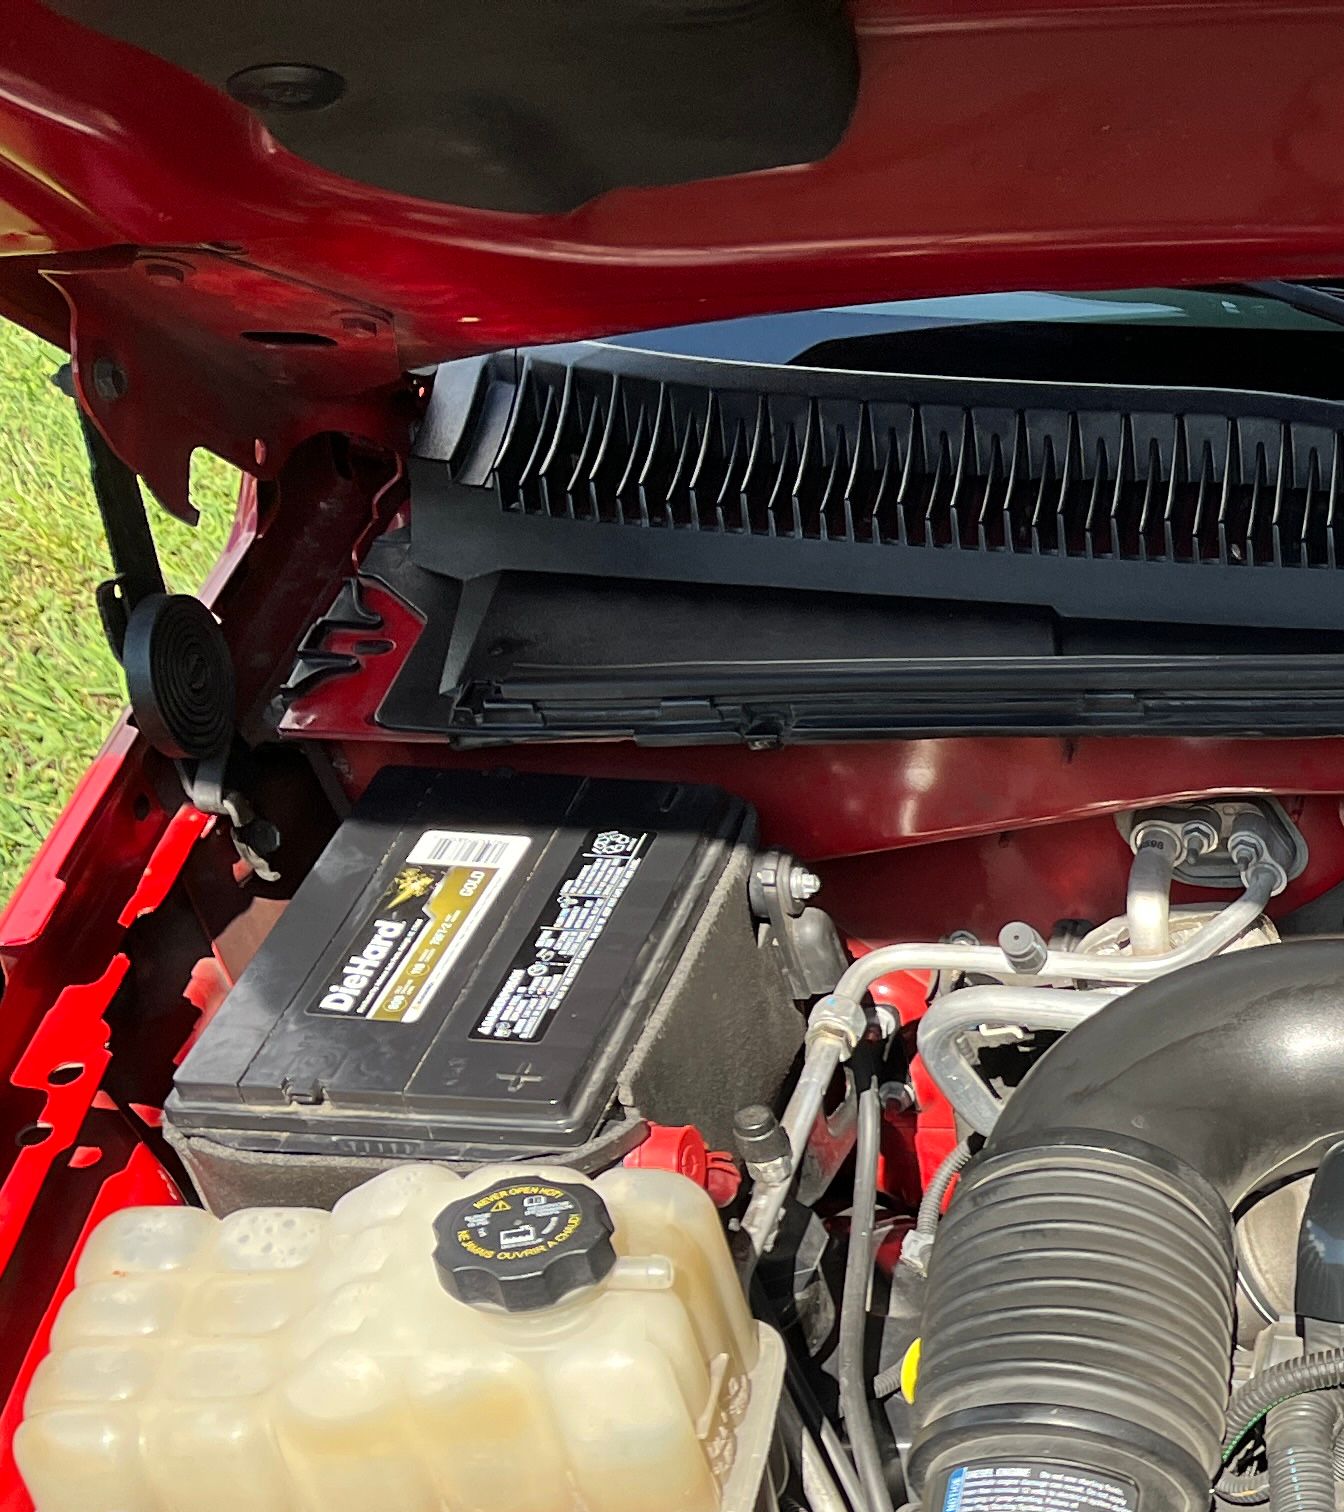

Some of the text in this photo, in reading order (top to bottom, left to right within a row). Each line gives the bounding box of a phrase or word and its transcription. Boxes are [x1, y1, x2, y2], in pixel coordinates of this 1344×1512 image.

[459, 870, 486, 897] GOLD
[318, 918, 407, 1012] DieHard
[473, 1190, 508, 1210] NEVER
[508, 1186, 539, 1196] OPEN
[496, 1245, 548, 1260] OUVRIR
